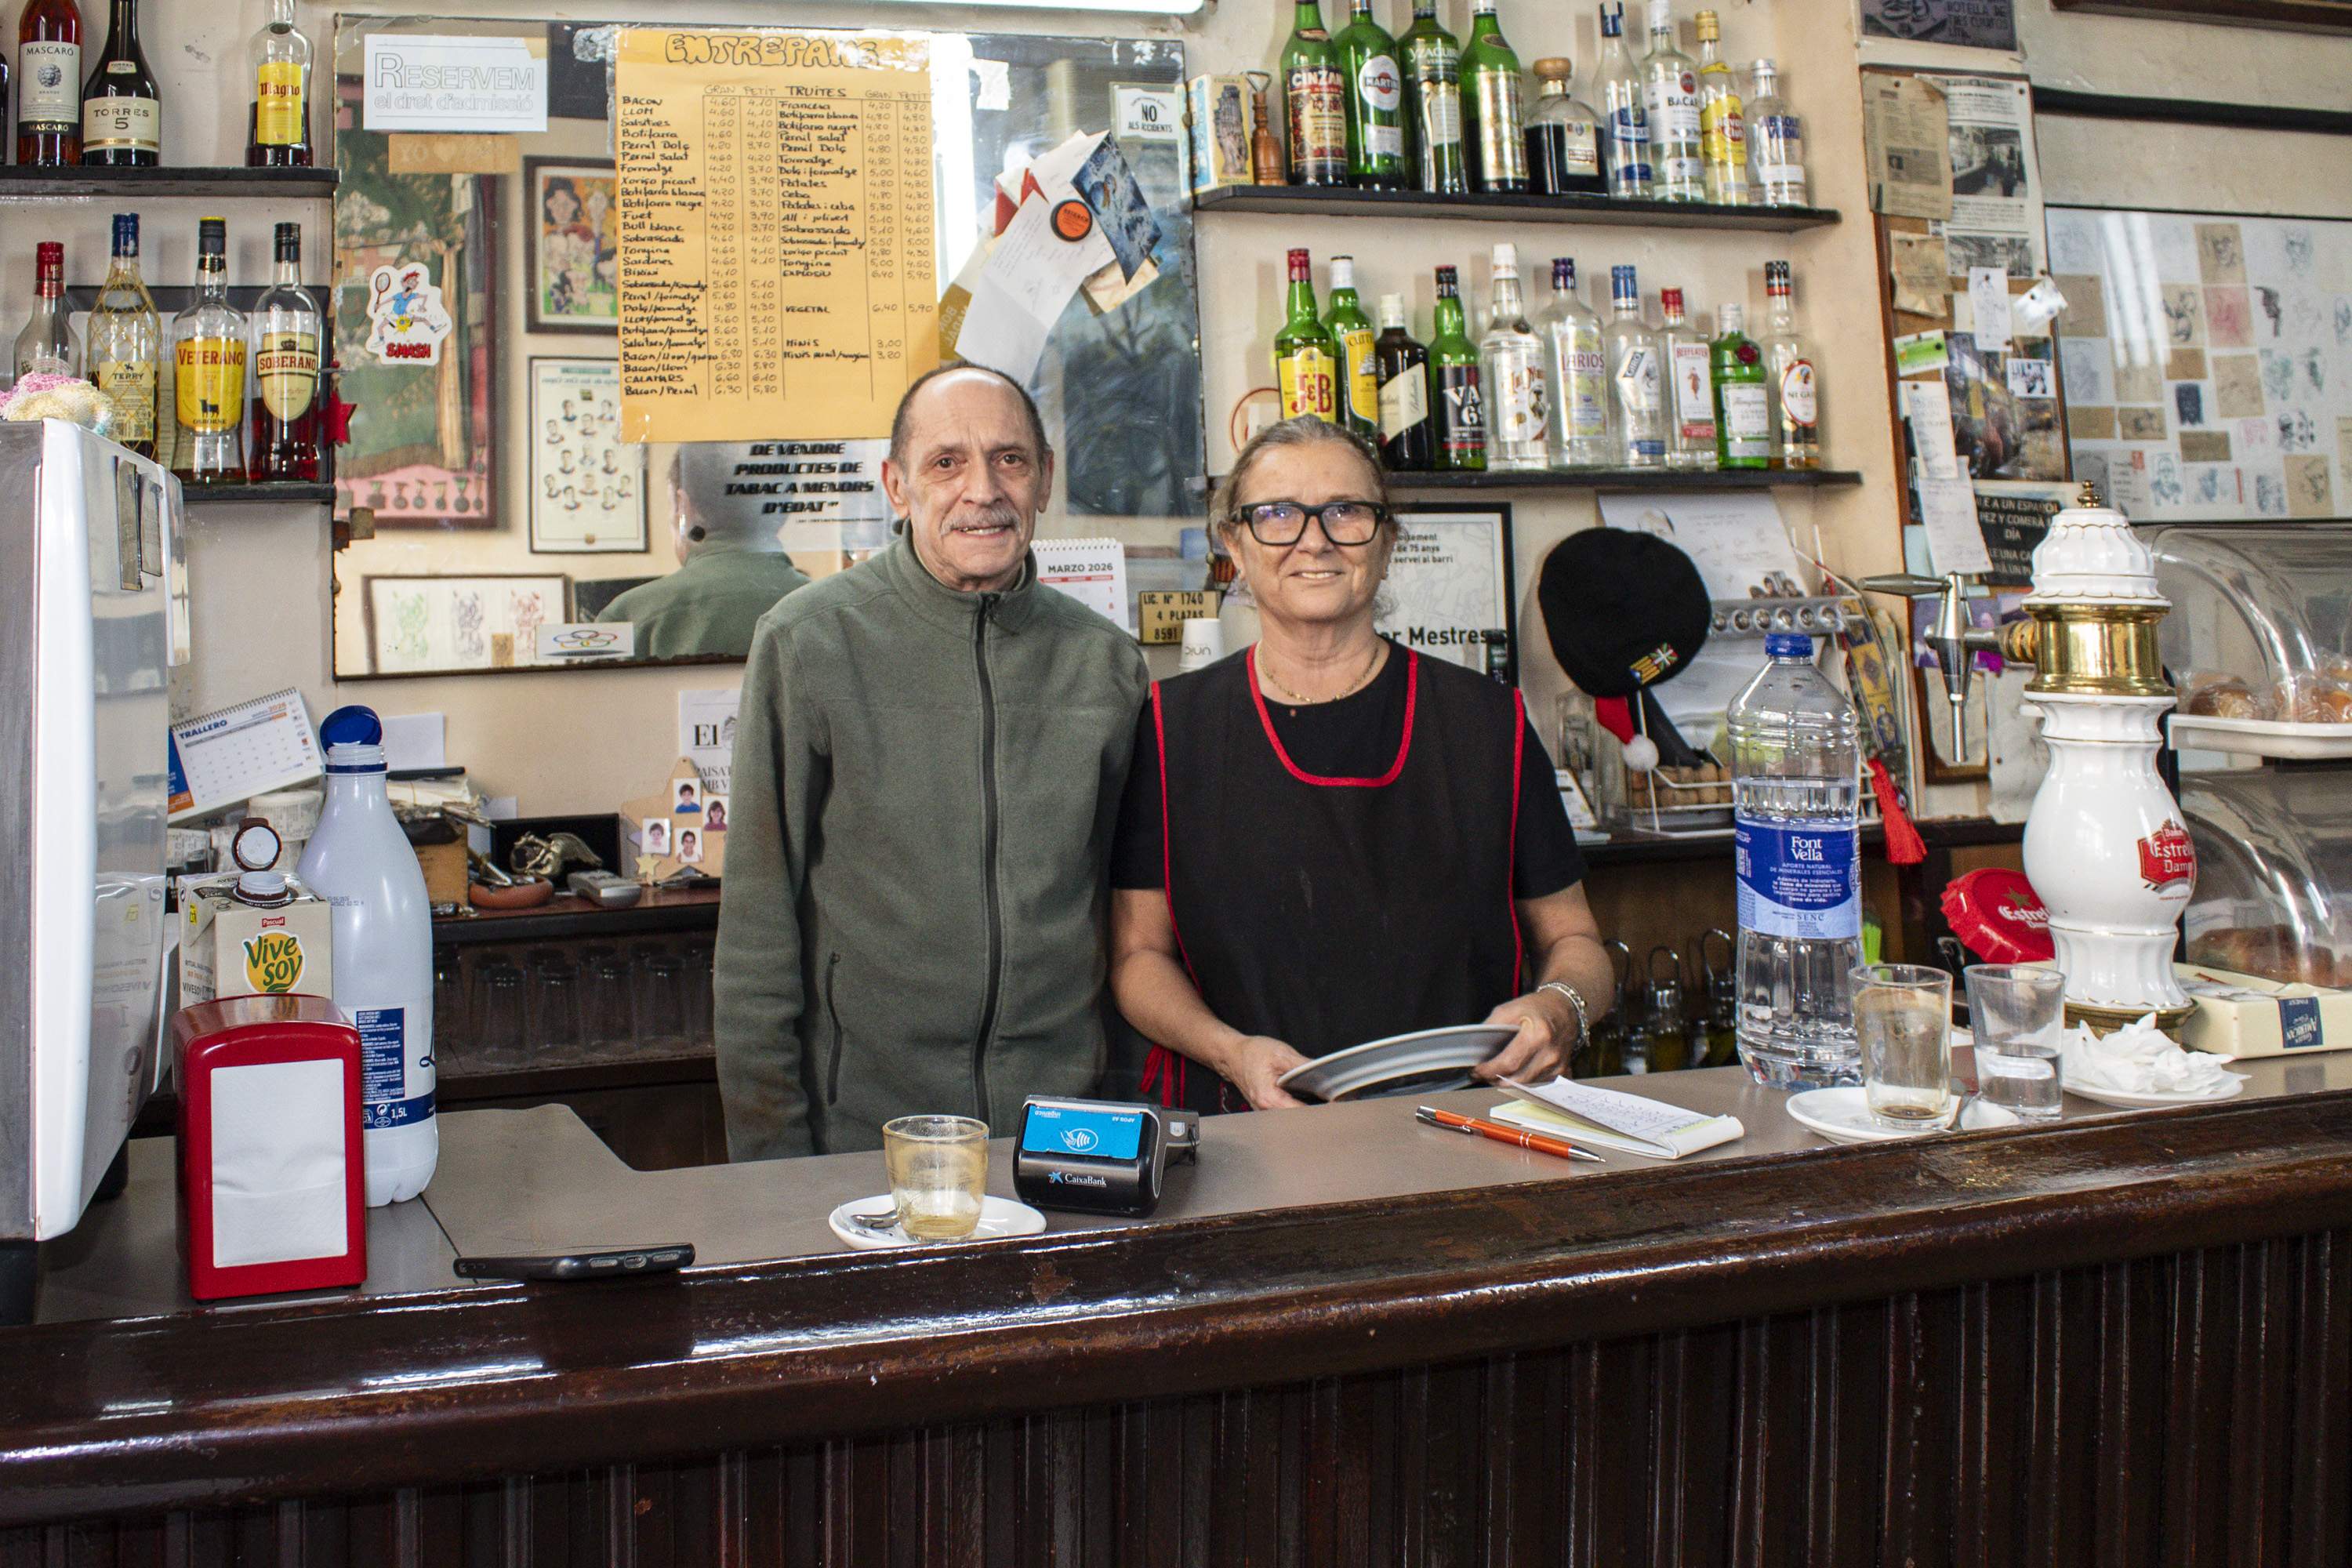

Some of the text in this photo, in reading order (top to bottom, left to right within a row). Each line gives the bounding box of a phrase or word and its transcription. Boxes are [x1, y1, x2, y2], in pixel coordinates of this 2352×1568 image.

[26, 45, 74, 56] MASCARÓ
[260, 82, 300, 99] Magno
[705, 85, 735, 94] GRAN
[375, 93, 533, 112] el dret d'admissió
[622, 96, 662, 105] BACON
[93, 108, 149, 118] TORRES
[1142, 103, 1157, 122] NO
[29, 123, 69, 132] MASCARÓ
[114, 118, 129, 129] 5
[1128, 121, 1173, 132] ALS ACCIDENTS
[662, 177, 696, 189] picant
[386, 342, 431, 358] SMASH
[1676, 347, 1708, 358] BEEFEATER
[178, 348, 244, 366] VETERANO
[260, 354, 318, 372] SOBERANO
[1562, 353, 1605, 371] LARIOS
[113, 372, 144, 380] TERRY
[1291, 372, 1332, 413] J&B
[750, 443, 846, 456] DE VENDRE
[734, 462, 863, 475] PRODUCTES DE
[724, 481, 874, 495] TABAC A MENORS
[2002, 501, 2015, 510] UN
[1432, 554, 1453, 563] barri
[1047, 563, 1113, 573] MARZO 2026
[1143, 592, 1158, 605] LIC.
[1181, 592, 1204, 605] 1740
[1156, 610, 1204, 621] 4 PLAZAS
[1154, 628, 1177, 641] 8591
[179, 720, 227, 739] TRALLERO
[1791, 837, 1823, 849] Font
[1791, 849, 1823, 861] Vella
[244, 935, 297, 969] Vive
[263, 955, 303, 985] soy
[391, 1107, 408, 1120] 1,5L
[1065, 1174, 1107, 1186] CaixaBank
